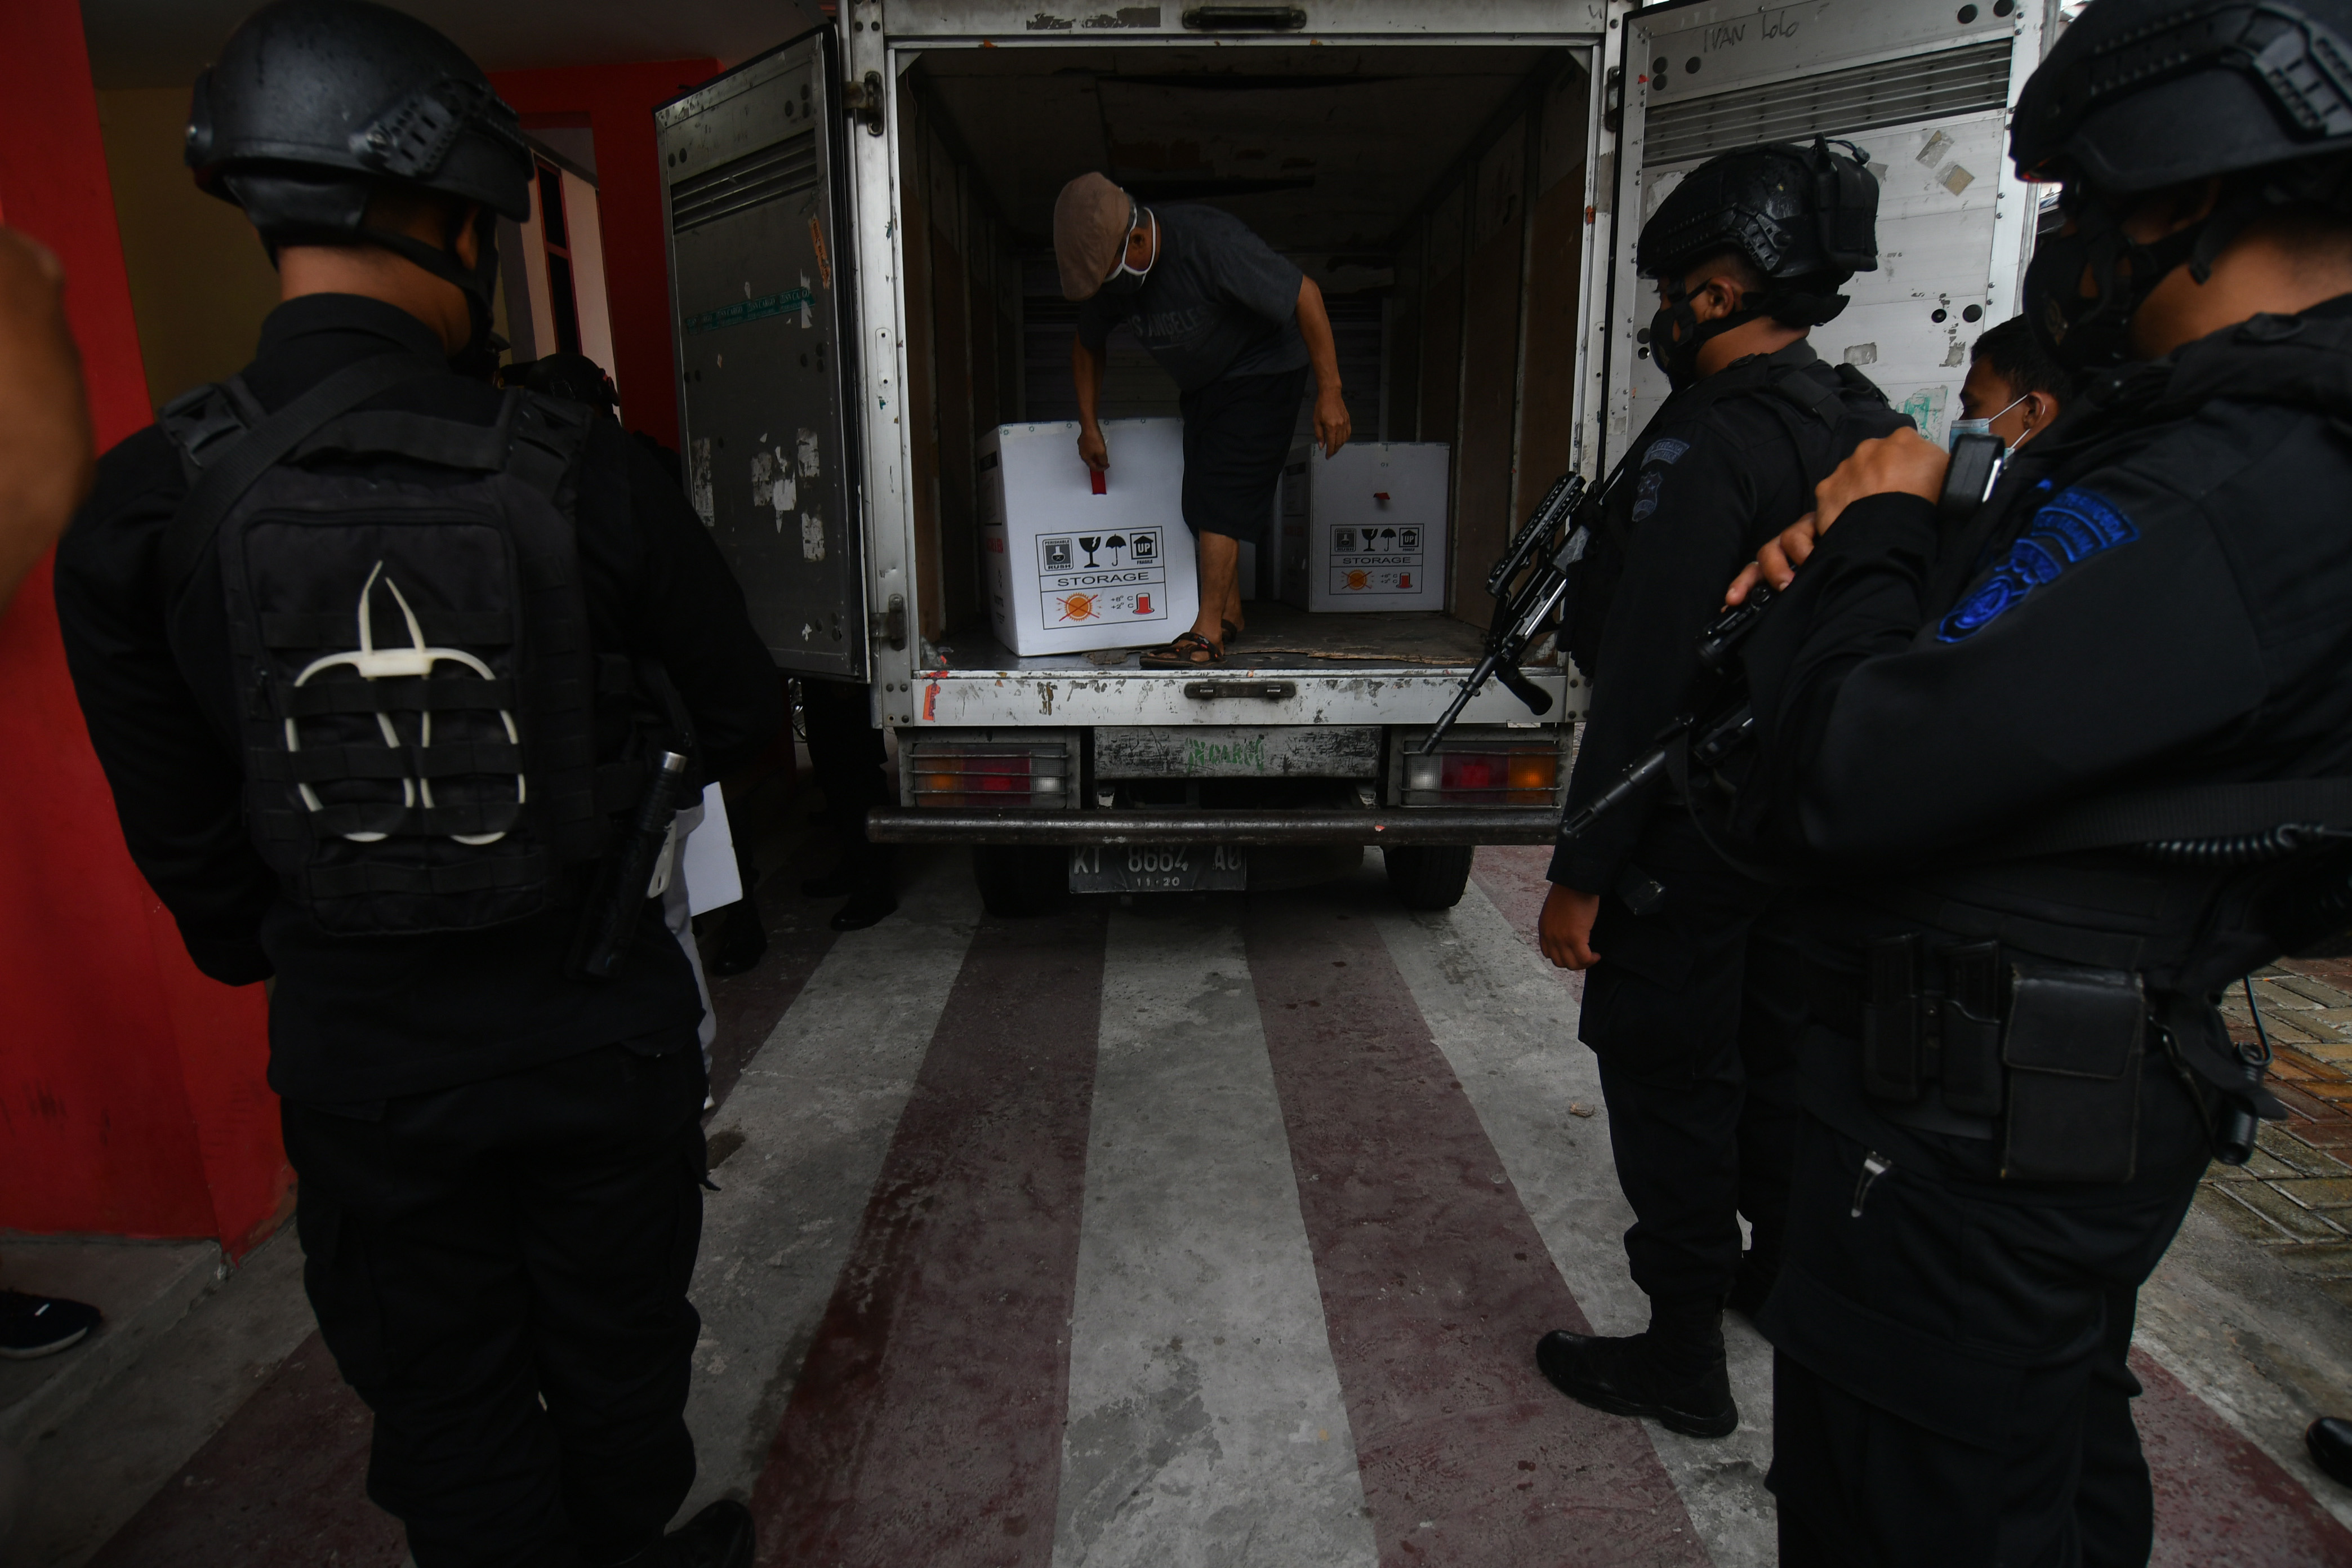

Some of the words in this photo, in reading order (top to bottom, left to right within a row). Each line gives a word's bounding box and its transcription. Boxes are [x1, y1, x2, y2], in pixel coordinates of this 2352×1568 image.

[1704, 24, 1745, 53] IVAN
[1137, 542, 1151, 554] UP
[1057, 572, 1150, 587] STORAGE
[1073, 845, 1104, 874] KT
[1128, 845, 1188, 872] 8664
